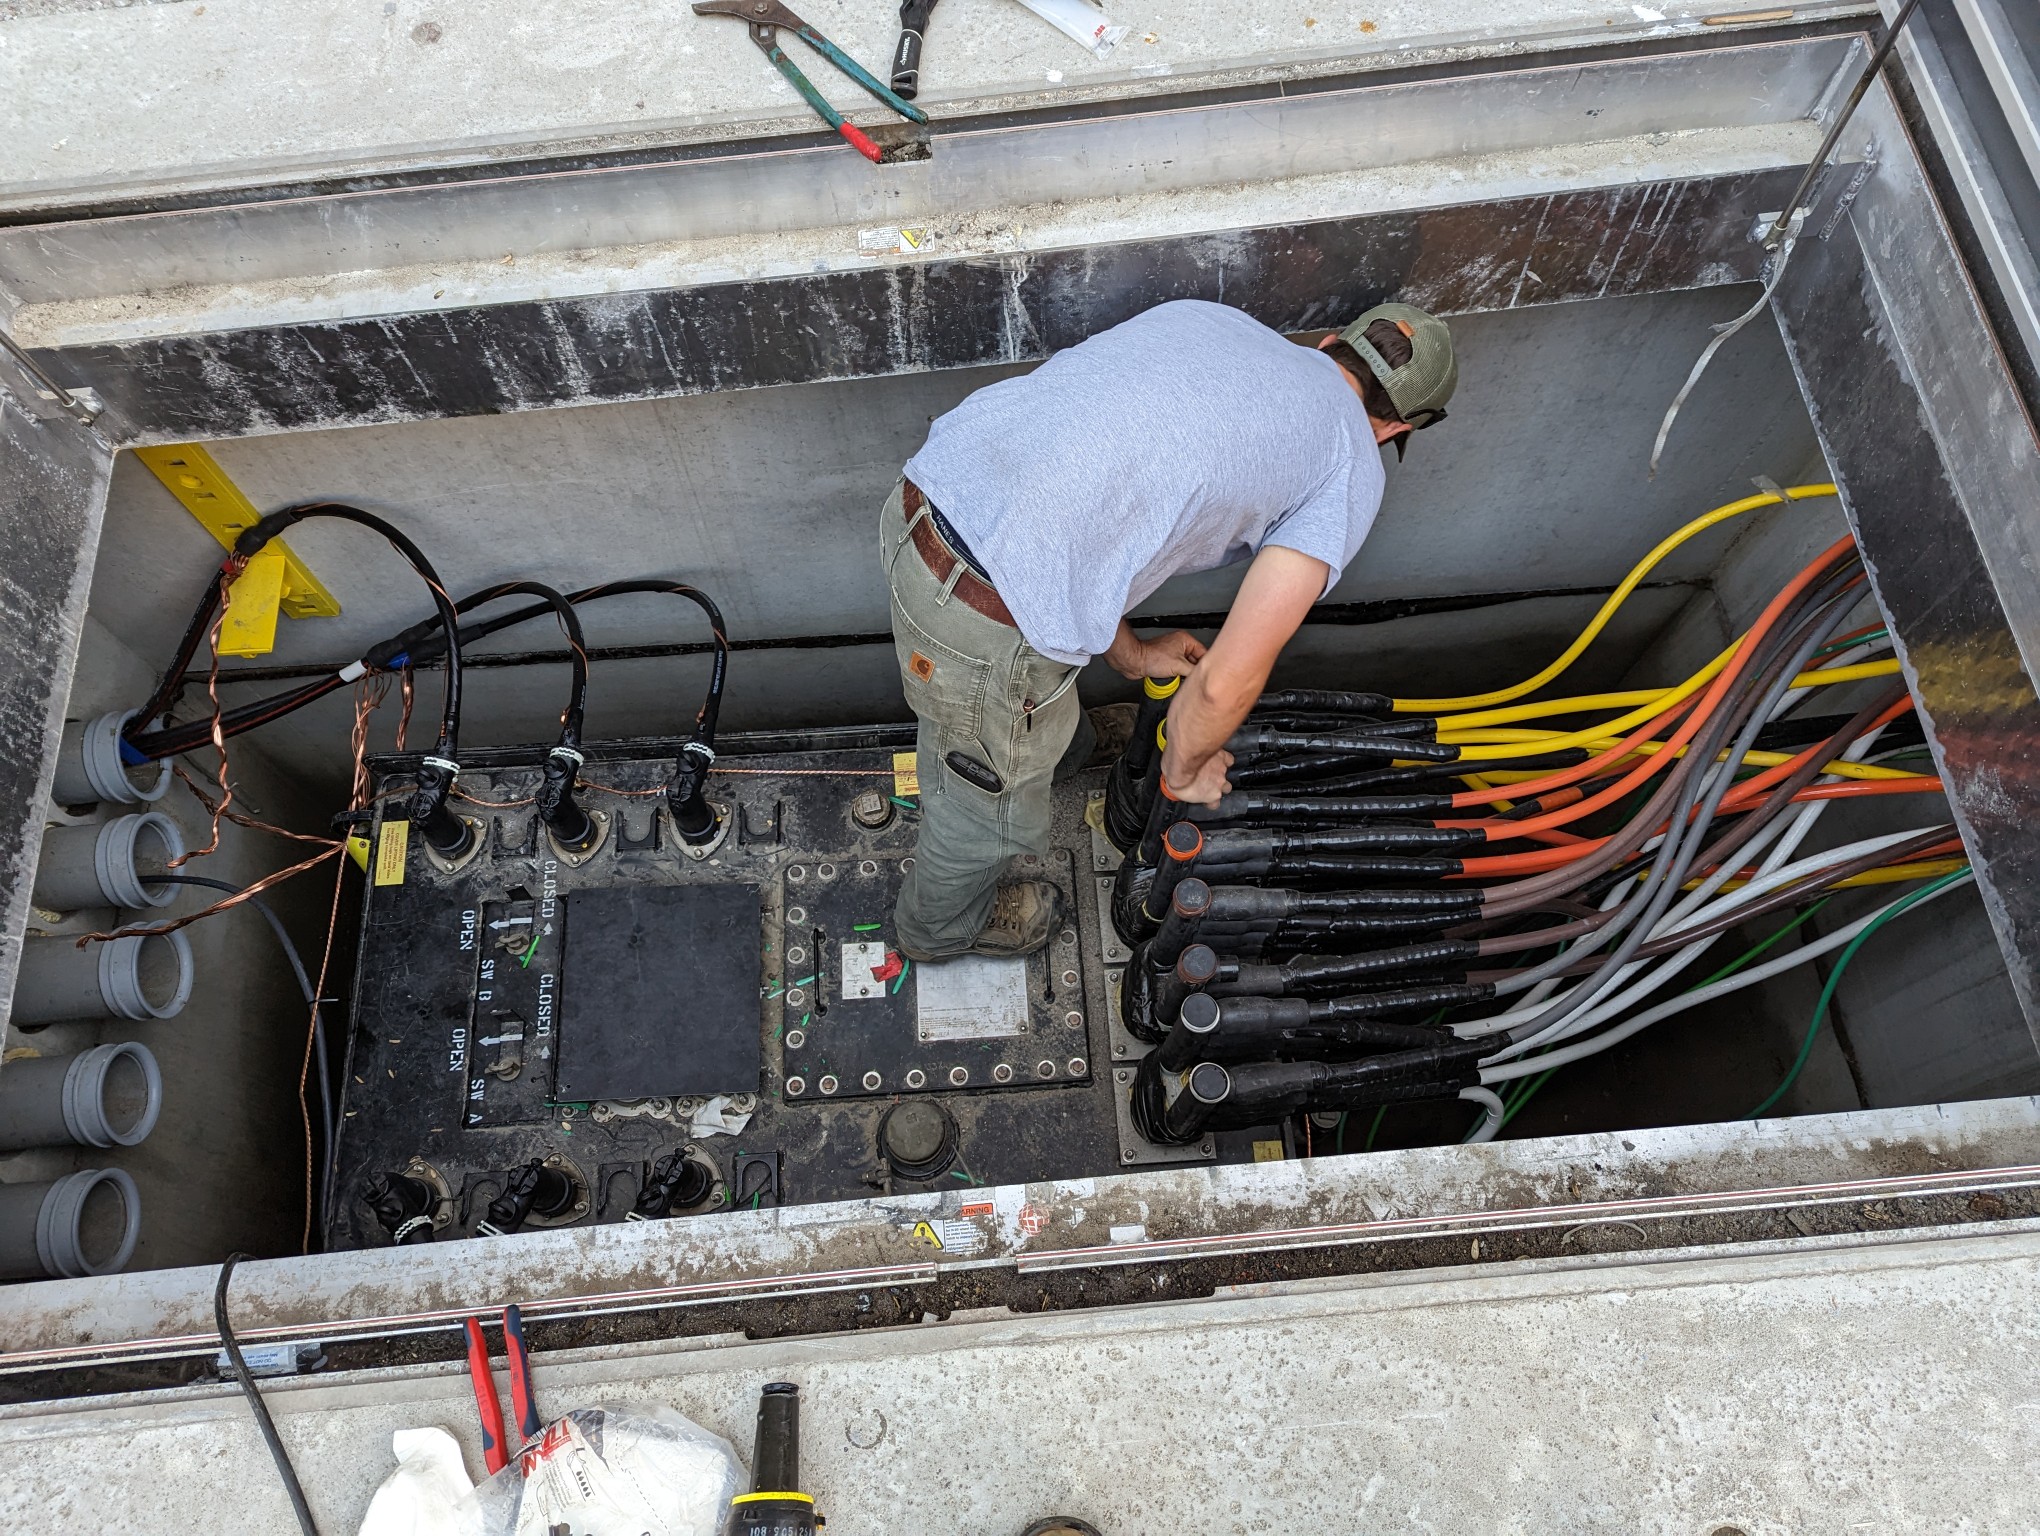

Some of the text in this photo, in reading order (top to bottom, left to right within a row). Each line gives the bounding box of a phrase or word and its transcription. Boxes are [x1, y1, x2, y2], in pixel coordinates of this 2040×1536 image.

[1094, 24, 1106, 38] ABB
[936, 514, 955, 544] HANES
[541, 860, 558, 918] CLOSED
[460, 910, 476, 950] OPEN
[478, 959, 495, 1001] SW B
[537, 973, 554, 1037] CLOSED
[449, 1028, 466, 1072] OPEN
[469, 1079, 485, 1124] SW A
[961, 1206, 990, 1216] ARNING
